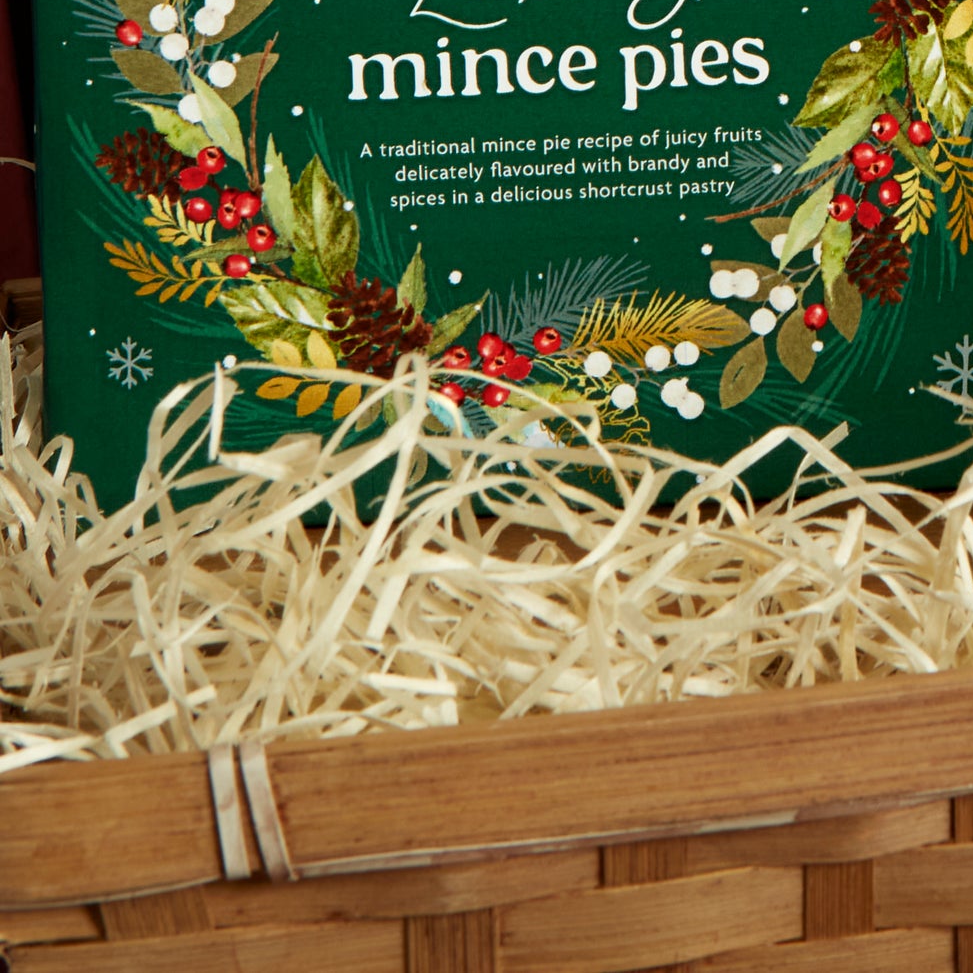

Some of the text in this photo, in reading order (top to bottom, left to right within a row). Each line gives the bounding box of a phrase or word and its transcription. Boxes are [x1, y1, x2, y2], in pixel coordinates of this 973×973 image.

[348, 27, 770, 111] mince pies
[360, 127, 762, 158] A traditional mince pie recipe of juicy fruits
[395, 151, 729, 182] delicately flavoured with brandy and
[390, 179, 735, 211] spices in a delicious shortcrust pastry
